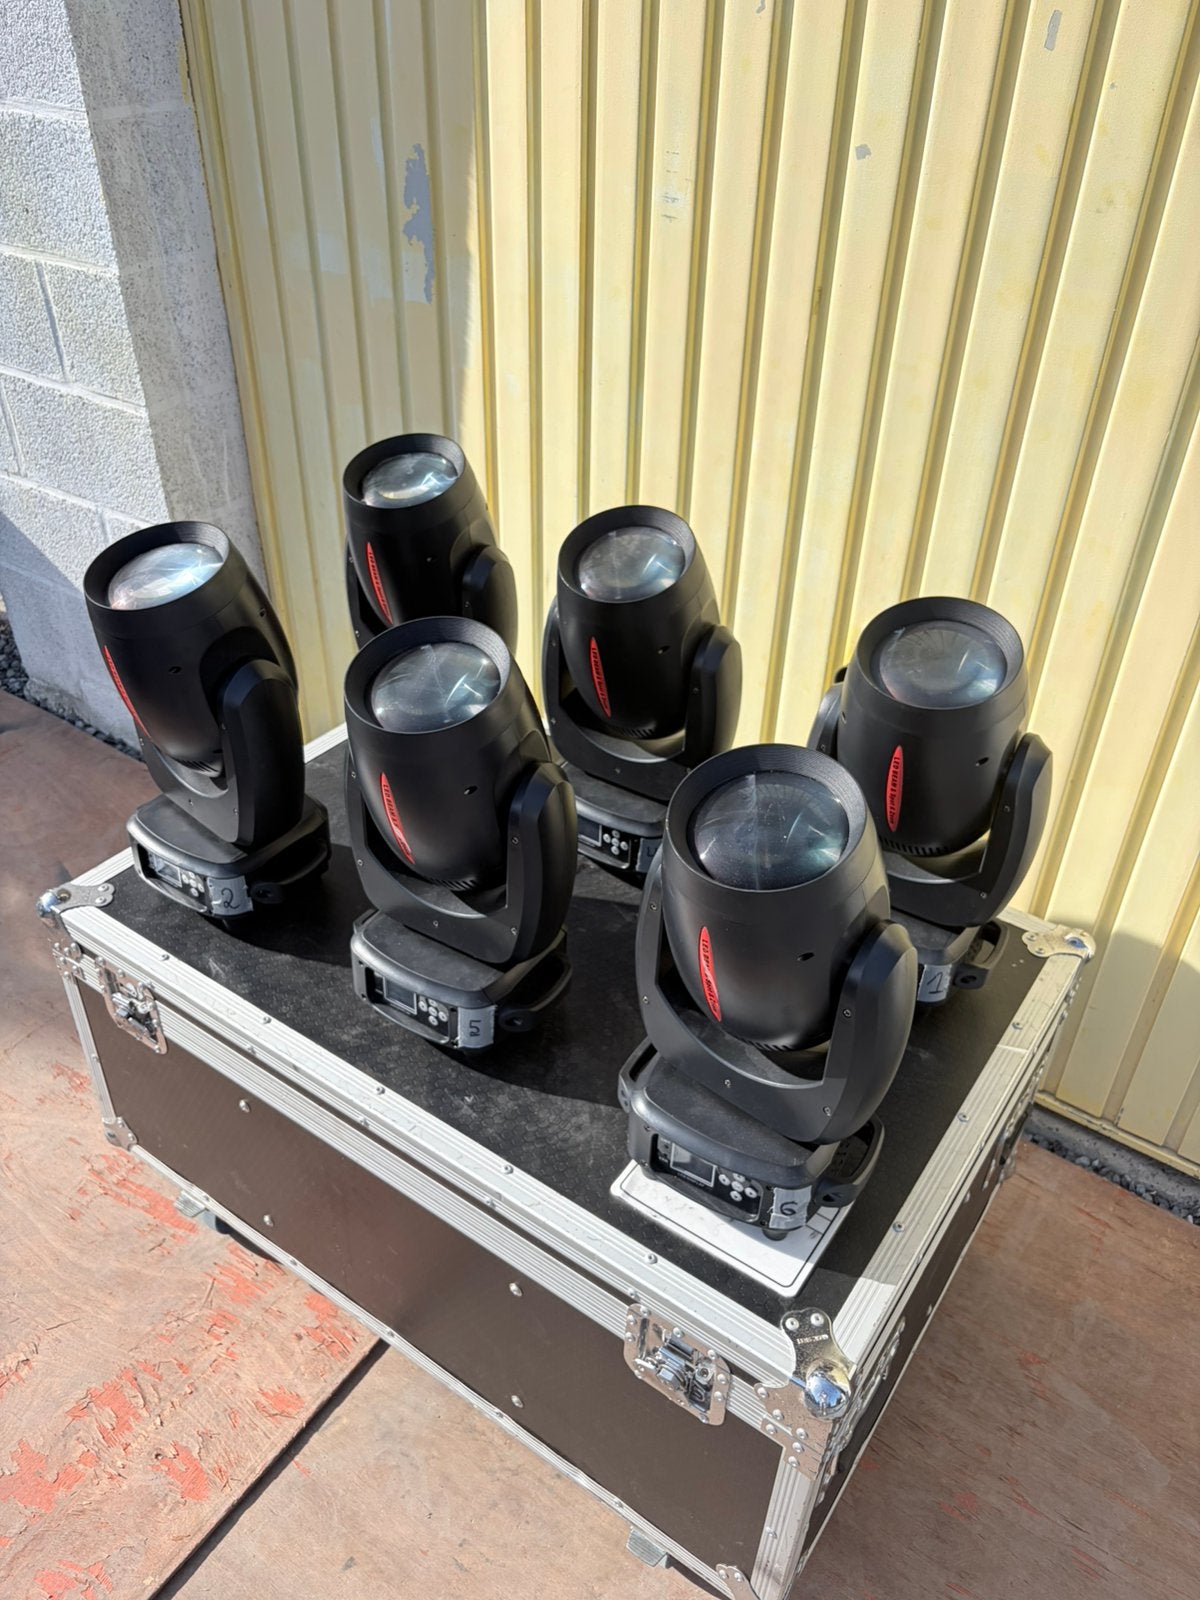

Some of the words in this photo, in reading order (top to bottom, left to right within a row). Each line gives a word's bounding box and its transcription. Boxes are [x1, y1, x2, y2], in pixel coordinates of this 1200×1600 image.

[890, 770, 899, 788] BEAM
[221, 887, 241, 910] 2
[701, 939, 709, 953] LED
[926, 971, 944, 995] 1
[469, 1019, 482, 1037] 5
[779, 1200, 799, 1217] 6
